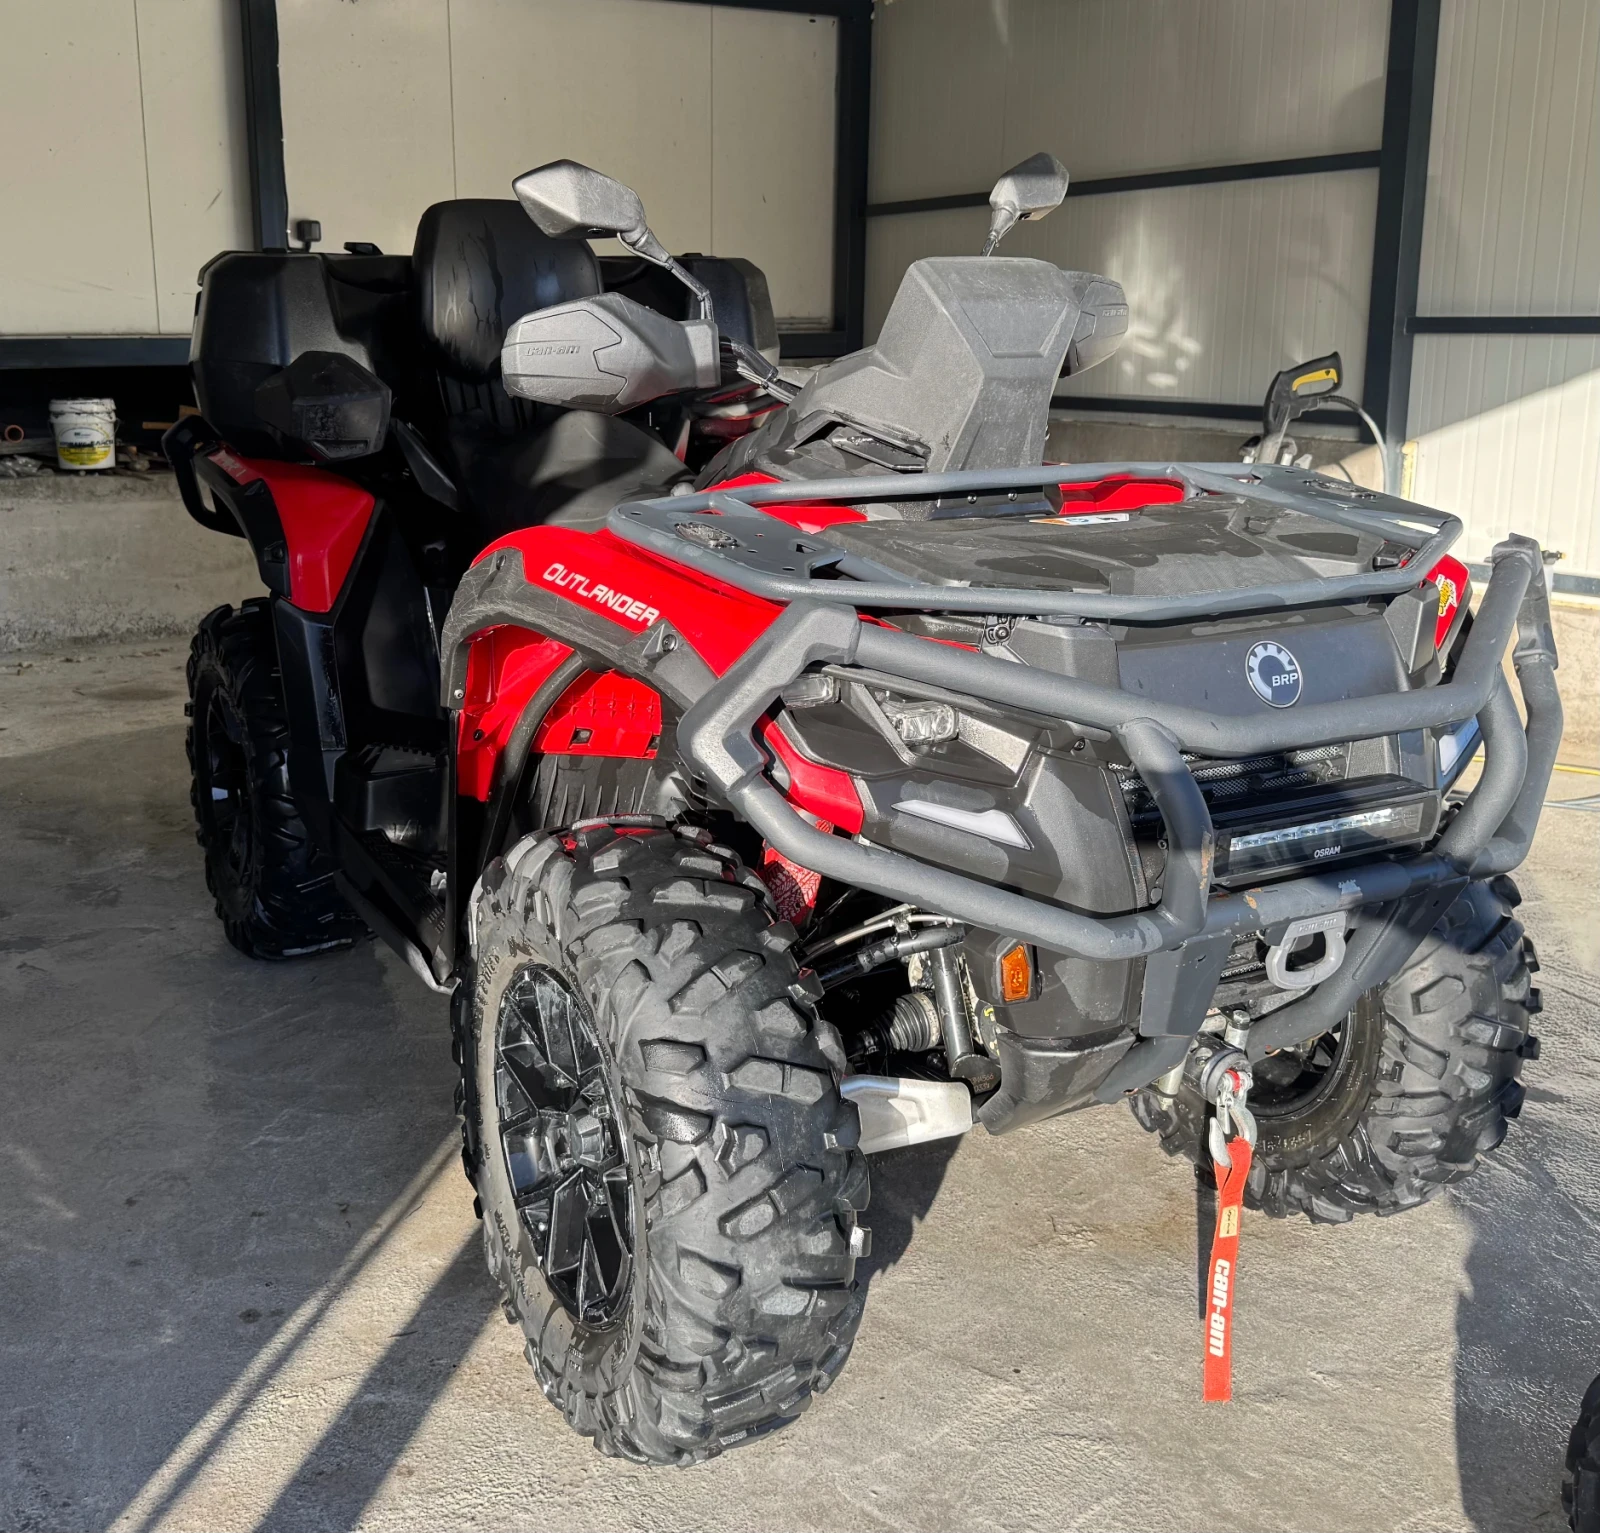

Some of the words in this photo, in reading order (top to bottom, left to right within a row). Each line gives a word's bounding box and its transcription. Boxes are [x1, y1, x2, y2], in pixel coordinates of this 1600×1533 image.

[542, 563, 660, 627] OUTLANDER
[1272, 672, 1298, 687] BRP
[1314, 845, 1341, 858] OSRAM
[1209, 1258, 1231, 1358] can-am
